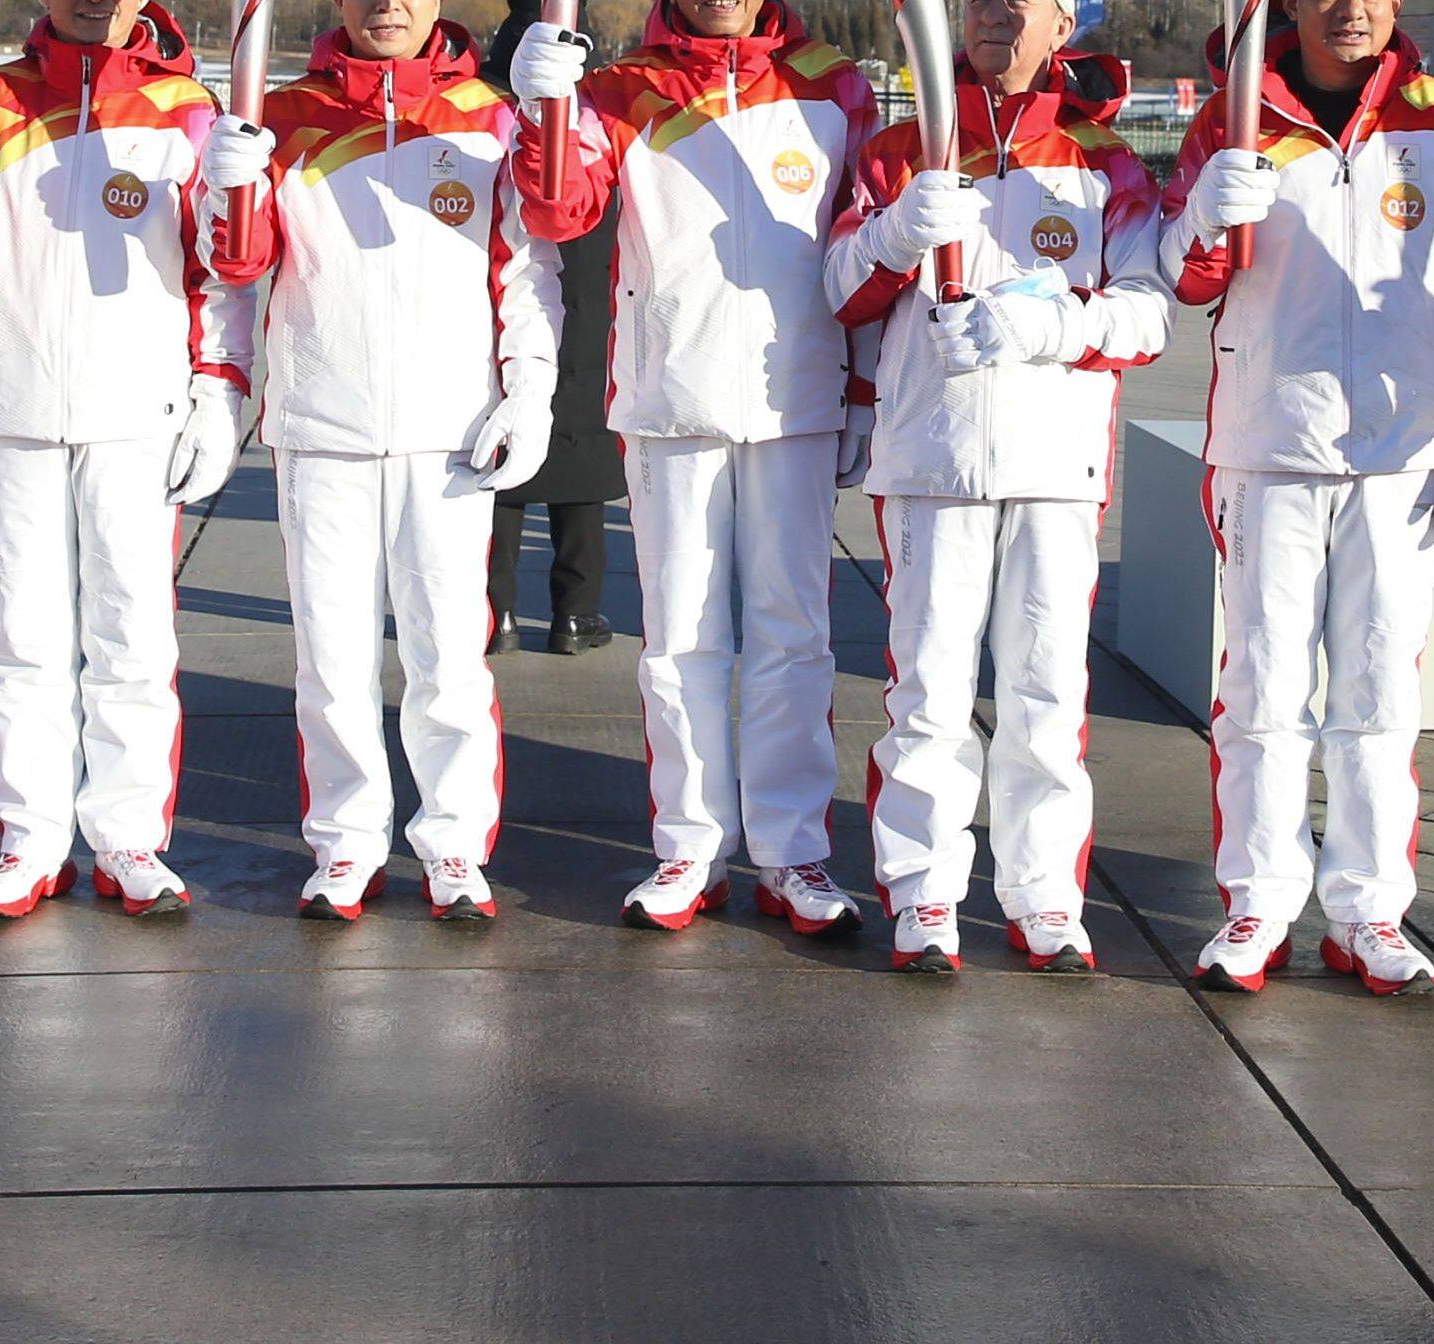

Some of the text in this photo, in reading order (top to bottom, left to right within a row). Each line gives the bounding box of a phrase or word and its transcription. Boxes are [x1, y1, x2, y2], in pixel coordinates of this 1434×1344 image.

[107, 188, 142, 208] 010
[434, 197, 469, 214] 002
[1387, 199, 1420, 218] 012
[1036, 232, 1074, 249] 004
[1233, 481, 1246, 566] BEIJING 2022
[901, 530, 912, 568] 2022
